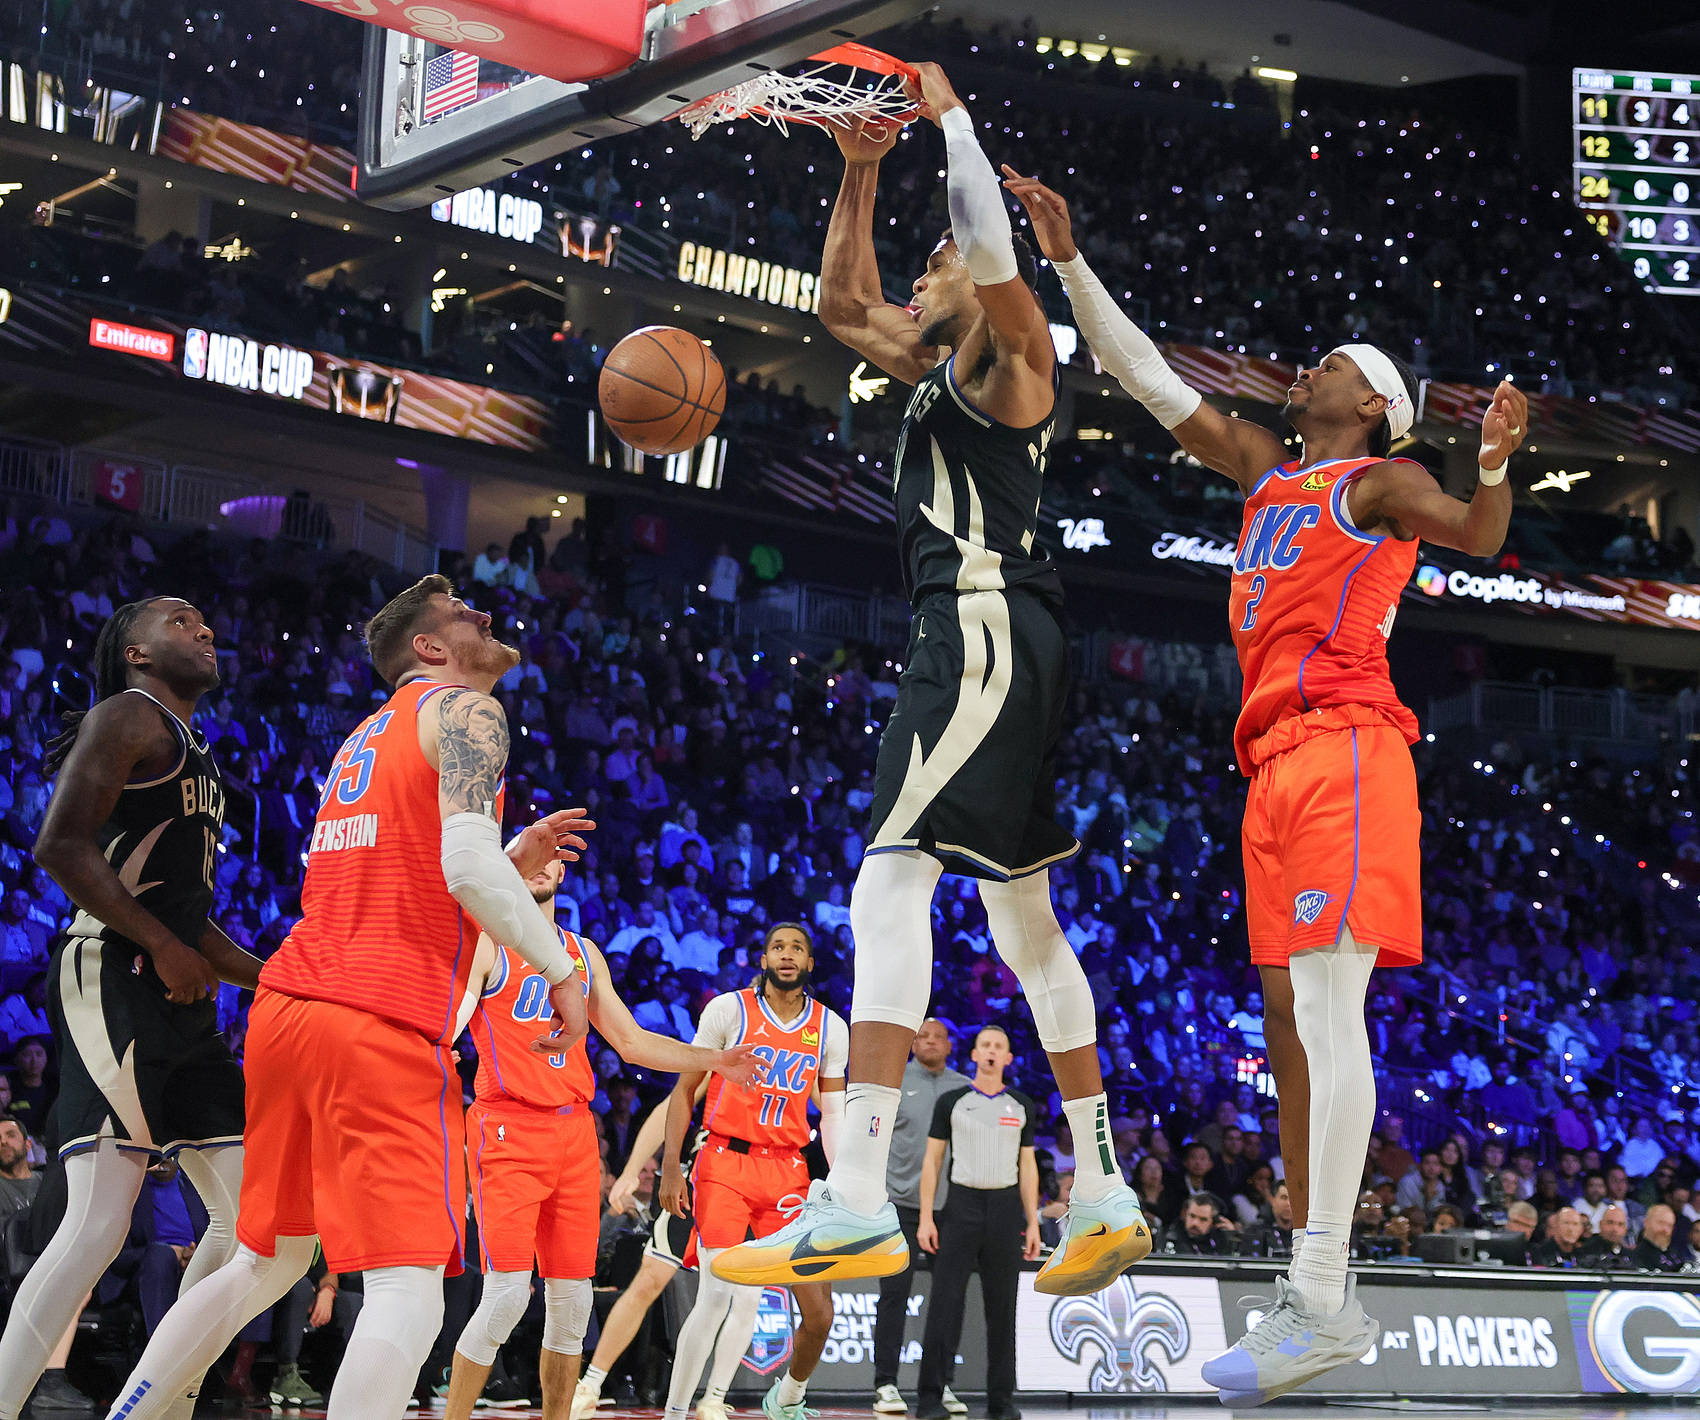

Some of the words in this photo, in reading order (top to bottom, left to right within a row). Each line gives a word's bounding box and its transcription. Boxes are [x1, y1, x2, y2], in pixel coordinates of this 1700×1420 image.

[1582, 98, 1608, 118] 11
[1633, 101, 1651, 122] 3
[1672, 103, 1690, 124] 4
[1582, 136, 1610, 158] 12
[1633, 139, 1651, 160] 3
[1673, 141, 1690, 162] 2
[1580, 176, 1611, 198] 24
[1633, 179, 1651, 201] 0
[1672, 182, 1690, 203] 0
[451, 187, 496, 234] NBA
[498, 194, 542, 243] CUP
[1628, 217, 1657, 239] 10
[1673, 219, 1690, 242] 3
[1672, 259, 1690, 281] 2
[95, 323, 168, 355] Emirates
[206, 332, 258, 391] NBA
[261, 344, 314, 399] CUP
[110, 471, 126, 499] 5
[1233, 504, 1321, 575] OKC
[1239, 574, 1267, 631] 2
[1448, 570, 1543, 603] Copilot
[1544, 589, 1561, 609] by
[1563, 591, 1625, 612] Microsoft
[320, 710, 396, 808] 55
[311, 813, 378, 852] ENSTEIN
[759, 1094, 788, 1127] 11
[791, 1292, 924, 1316] ONDY
[1383, 1332, 1411, 1350] AT
[1413, 1315, 1558, 1369] PACKERS
